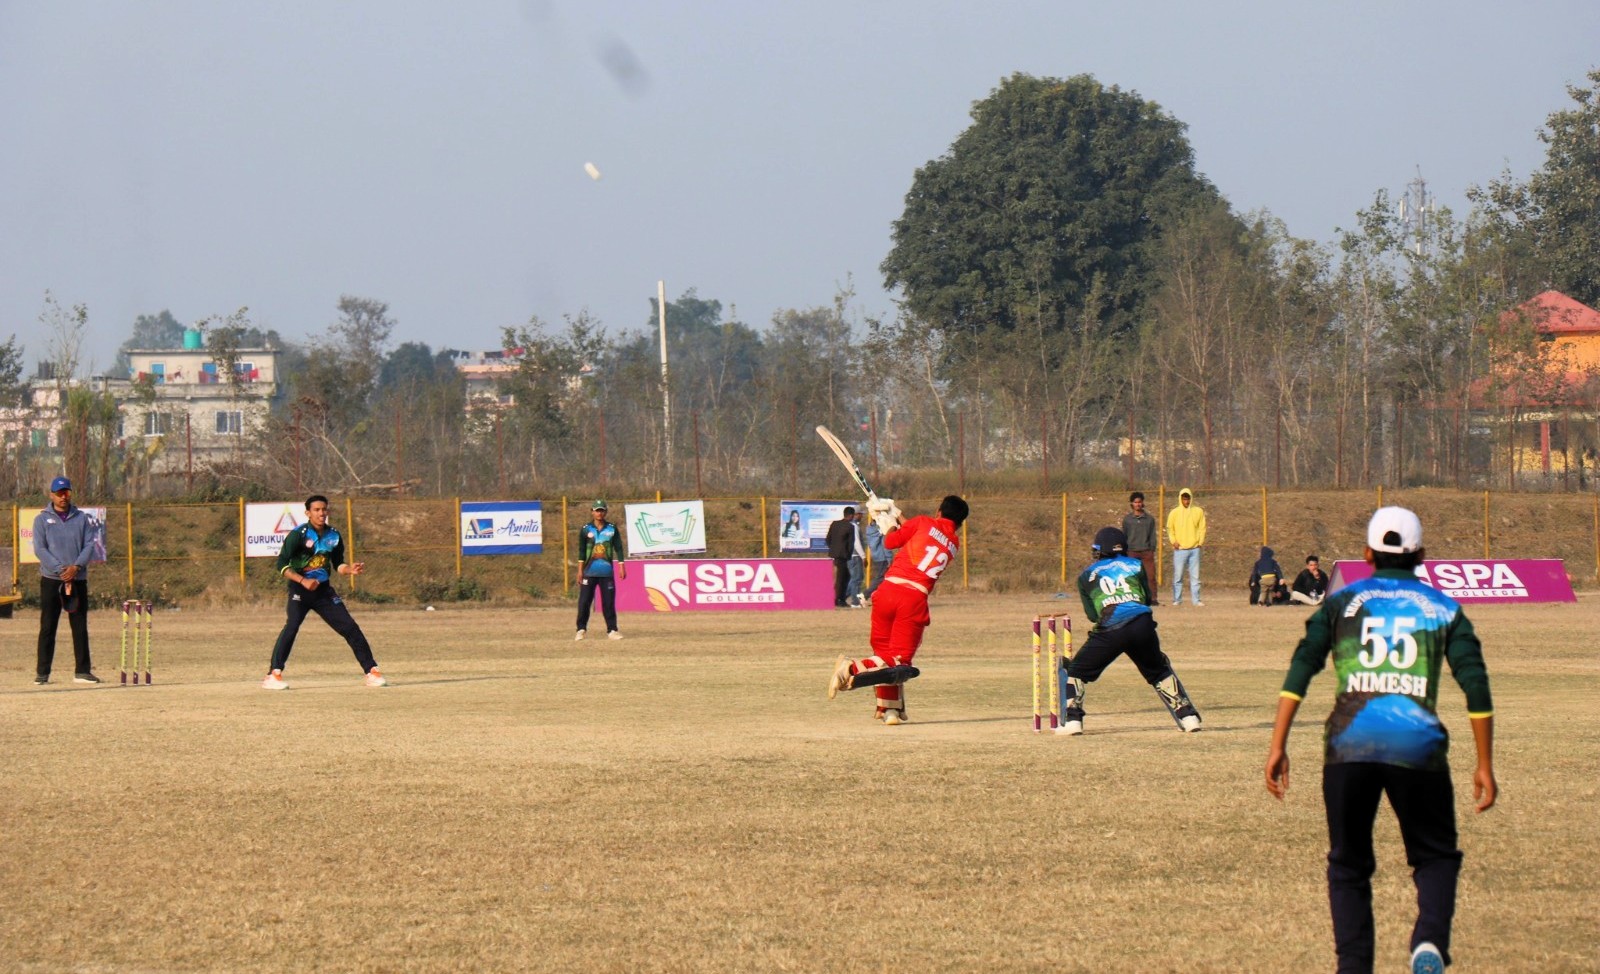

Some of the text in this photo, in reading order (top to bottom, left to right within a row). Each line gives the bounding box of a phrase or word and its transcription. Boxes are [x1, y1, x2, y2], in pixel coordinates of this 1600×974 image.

[917, 545, 949, 579] 12
[1099, 574, 1132, 596] 04
[1358, 616, 1418, 669] 55
[1346, 671, 1428, 698] NIMESH
